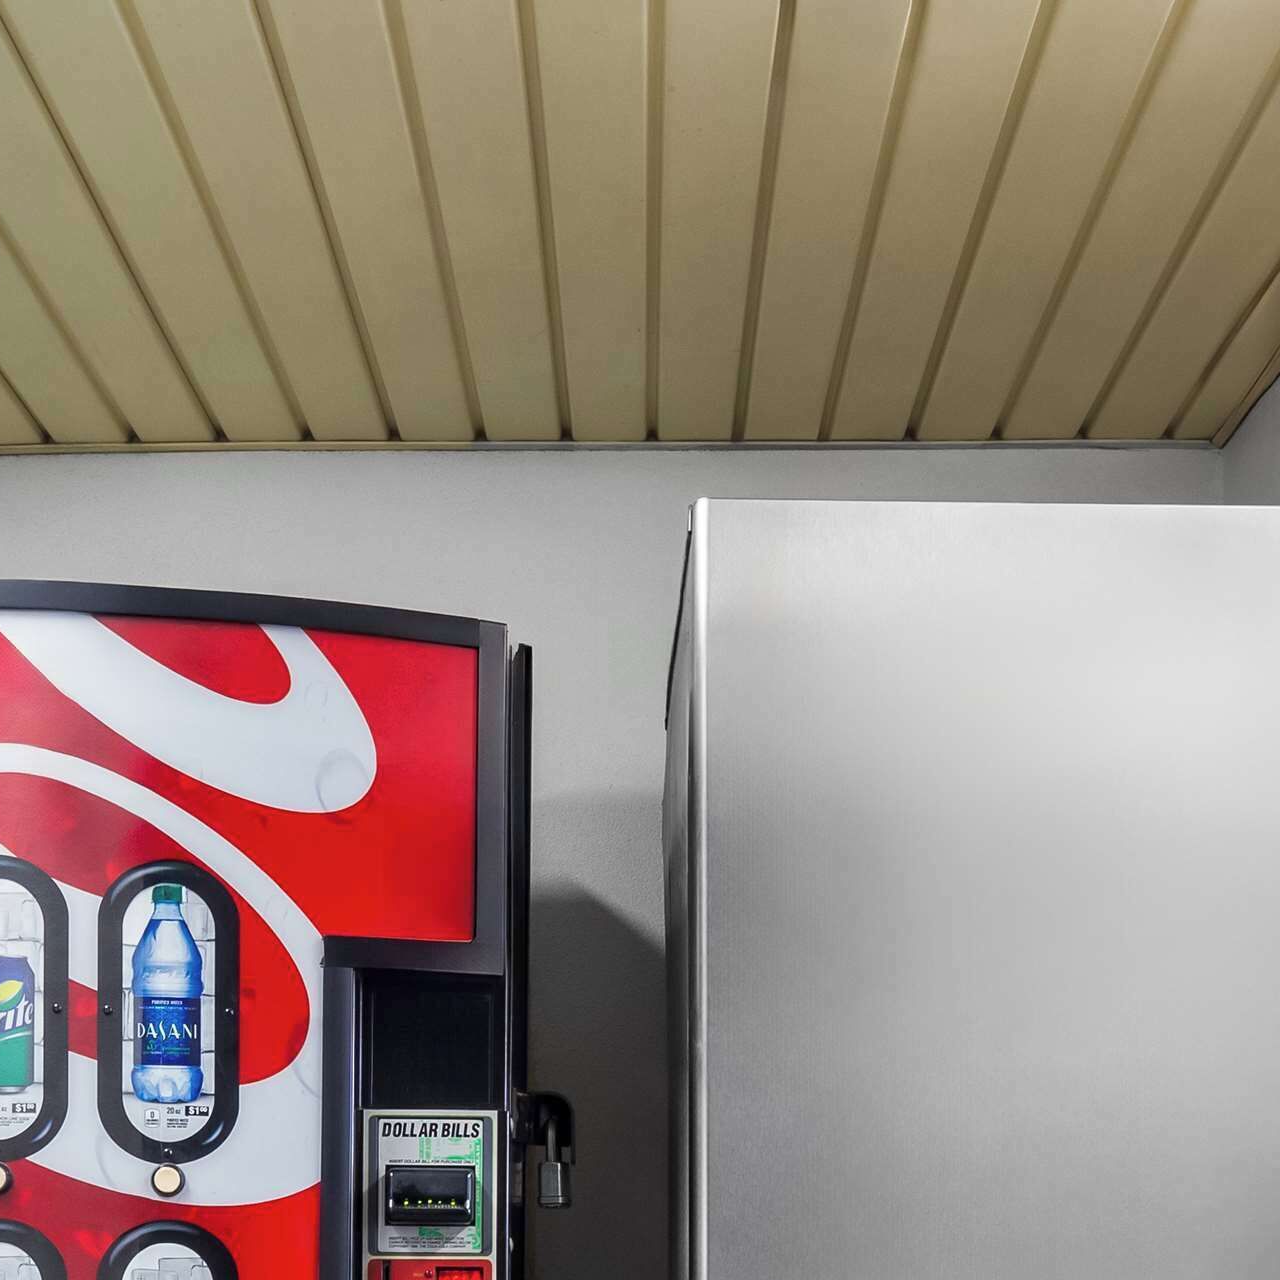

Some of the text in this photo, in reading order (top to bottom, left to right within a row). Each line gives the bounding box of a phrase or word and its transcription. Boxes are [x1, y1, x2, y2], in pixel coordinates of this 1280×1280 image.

[137, 1020, 198, 1041] DASANI
[381, 1122, 481, 1138] DOLLAR BILLS
